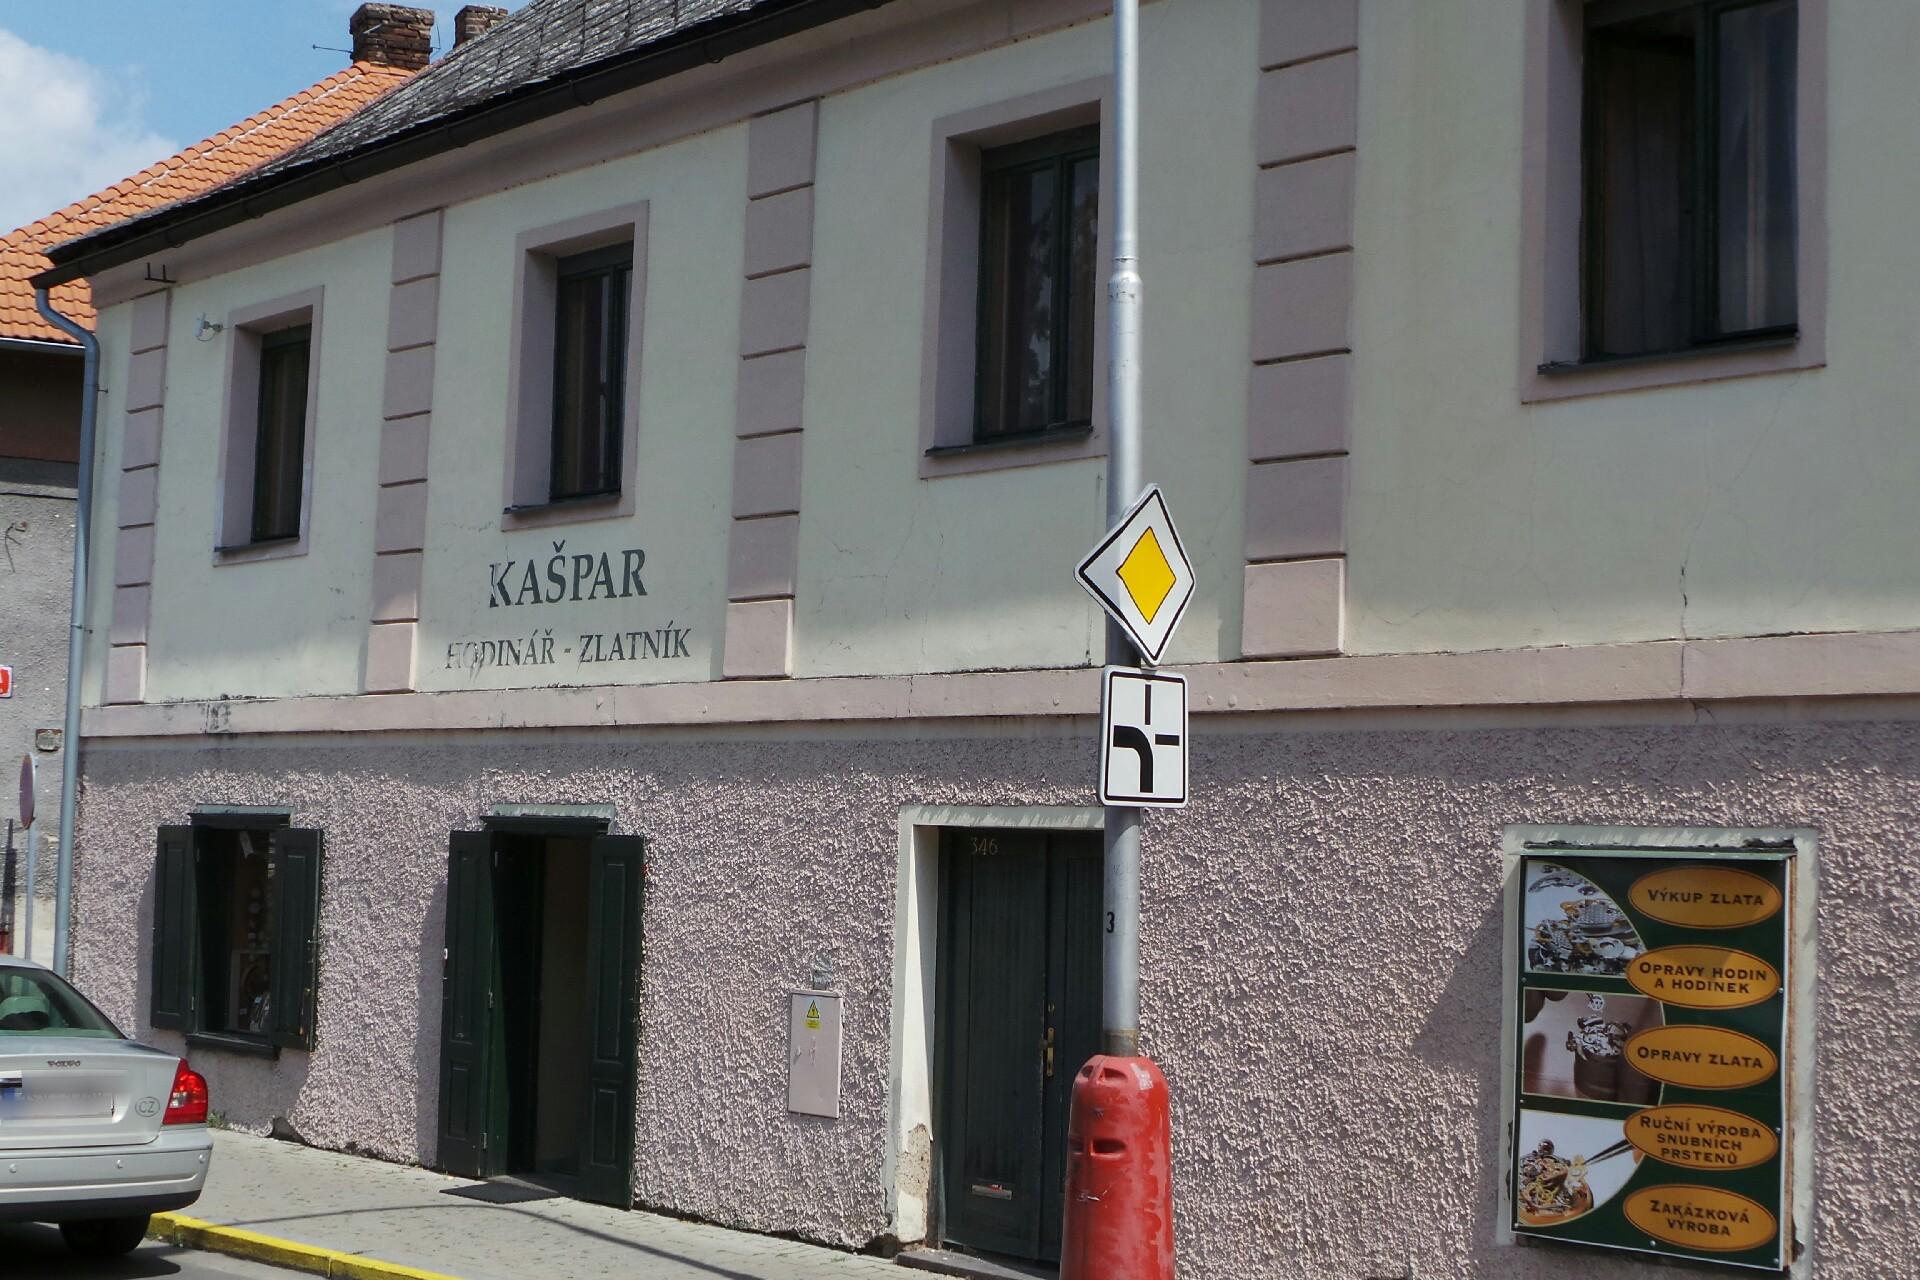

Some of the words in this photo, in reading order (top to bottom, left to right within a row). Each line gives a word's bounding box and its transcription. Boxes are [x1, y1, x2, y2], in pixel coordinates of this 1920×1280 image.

[489, 539, 648, 608] KAŠPAR
[579, 619, 692, 664] ZLATNÍK
[970, 836, 999, 856] 346
[1648, 887, 1703, 903] VÝKUP
[1711, 892, 1764, 906] ZLATA
[1106, 911, 1116, 934] 3
[1639, 962, 1704, 977] OPRAVY
[1713, 968, 1767, 981] HODIN
[1654, 978, 1665, 990] A
[1672, 979, 1749, 994] HODINEK
[1637, 1045, 1702, 1064] OPRAVY
[1709, 1053, 1764, 1070] ZLATA
[138, 1100, 155, 1114] CZ
[1697, 1119, 1761, 1139] VÝROBA
[1656, 1131, 1743, 1151] SNUBNÍCH
[1660, 1147, 1739, 1166] PRSTENŮ
[1650, 1199, 1750, 1225] ZAKÁZKOVÁ
[1666, 1213, 1732, 1237] VÝROBA
